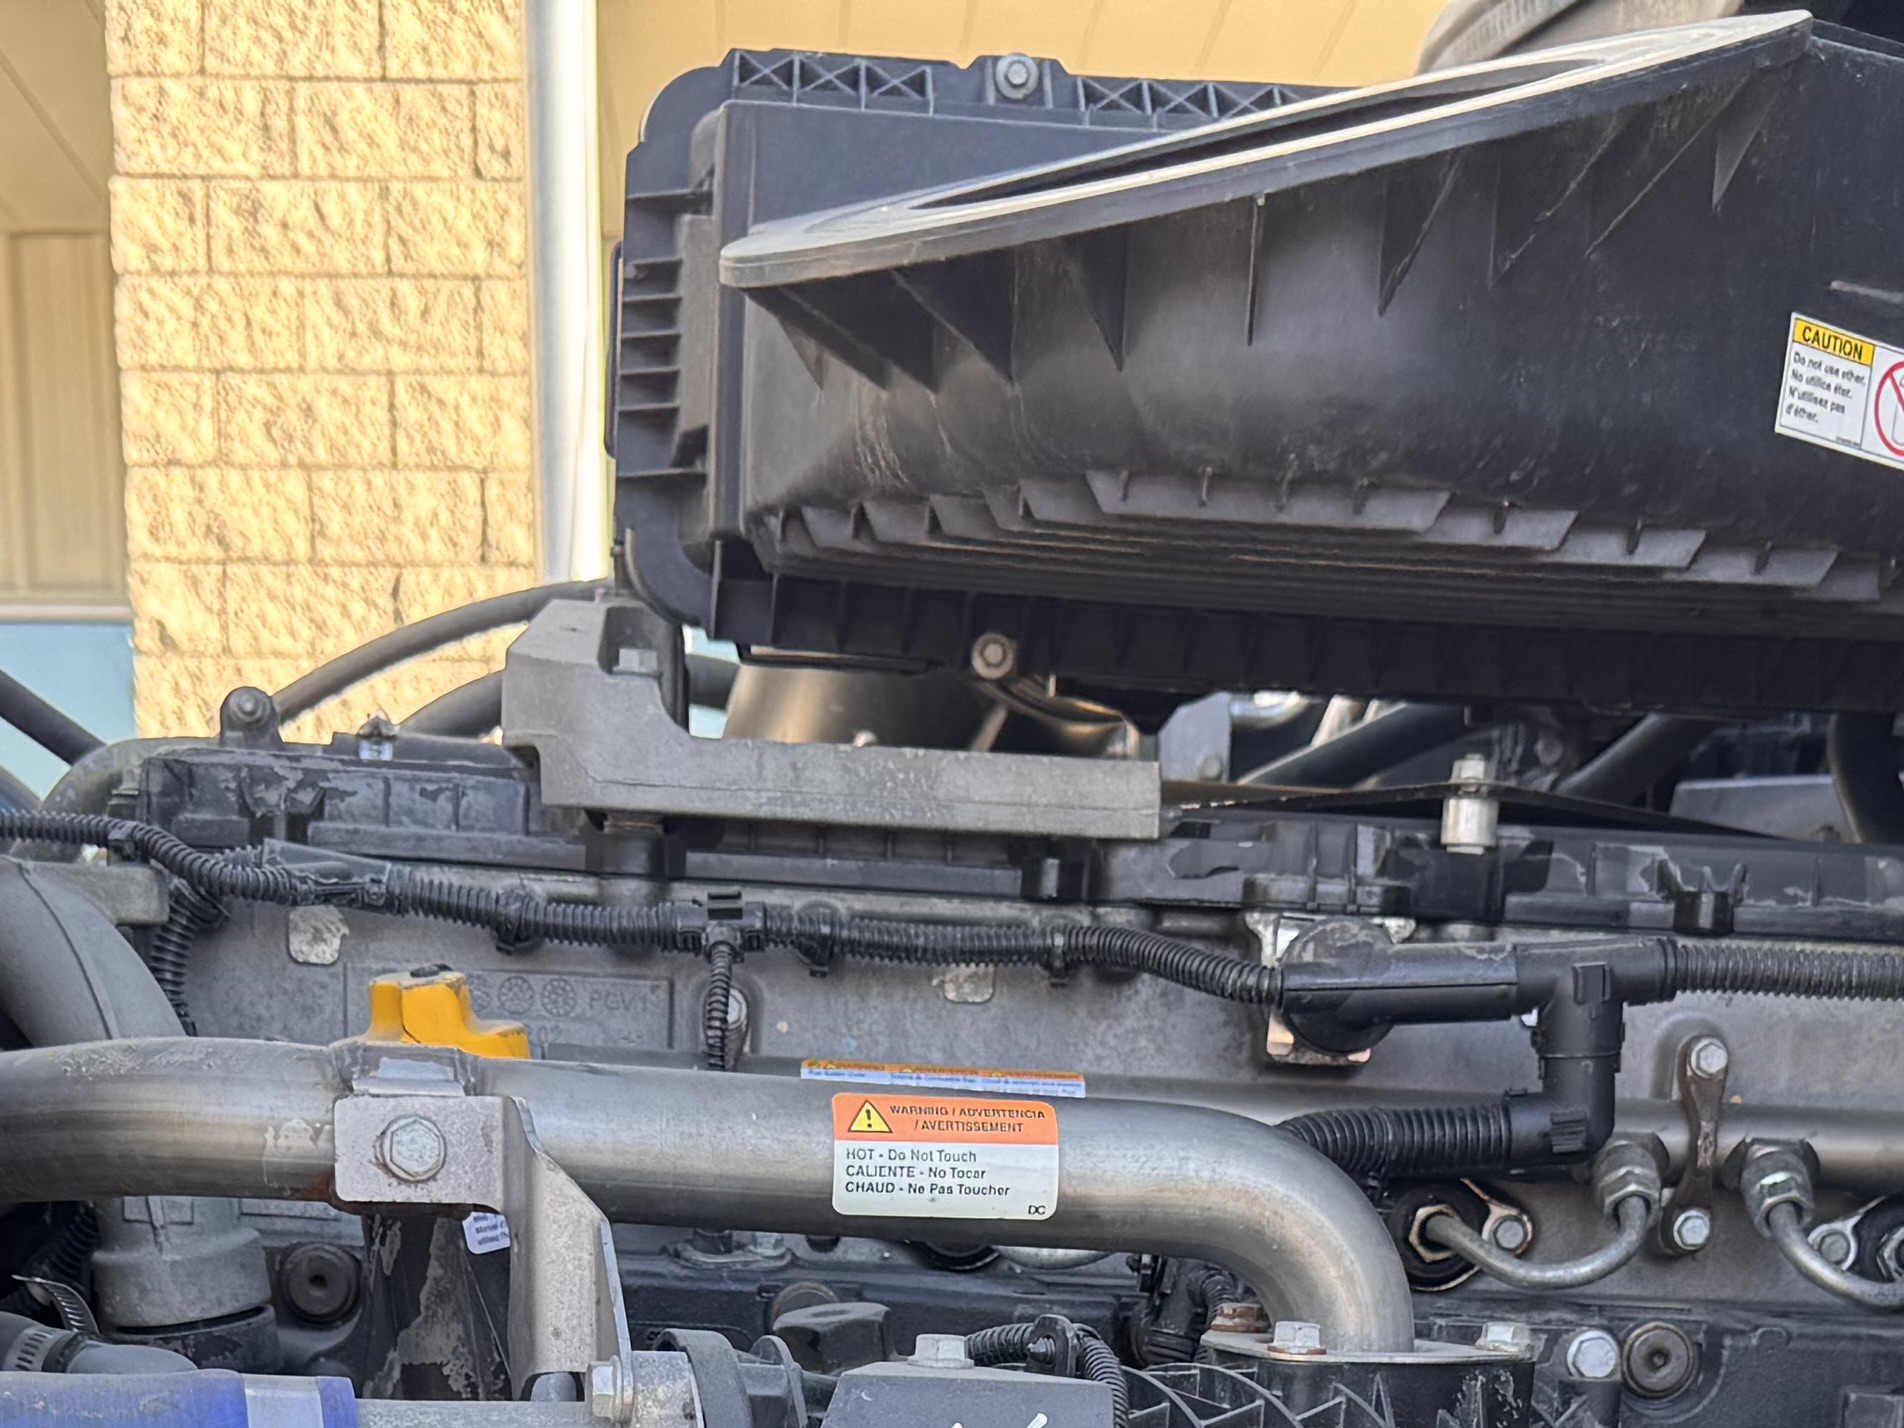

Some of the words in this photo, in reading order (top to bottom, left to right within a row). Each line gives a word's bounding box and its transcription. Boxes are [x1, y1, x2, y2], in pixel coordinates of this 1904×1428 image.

[1801, 325, 1864, 361] CAUTION
[1793, 351, 1806, 366] Do
[1808, 357, 1823, 371] not
[1824, 363, 1840, 377] use
[1791, 369, 1804, 384] No
[889, 1104, 950, 1117] WARNING
[959, 1107, 1046, 1120] ADVERTENCIA
[921, 1120, 1024, 1133] AVERTISSEMENT
[846, 1148, 876, 1160] HOT
[888, 1149, 907, 1162] Do
[910, 1149, 934, 1162] Not
[937, 1150, 977, 1163] Touch
[845, 1164, 916, 1178] CALIENTE
[928, 1166, 947, 1179] No
[949, 1167, 987, 1180] Tocar
[845, 1180, 896, 1194] CHAUD
[929, 1182, 954, 1195] Pas
[958, 1183, 1011, 1197] Toucher
[1027, 1204, 1047, 1216] DC
